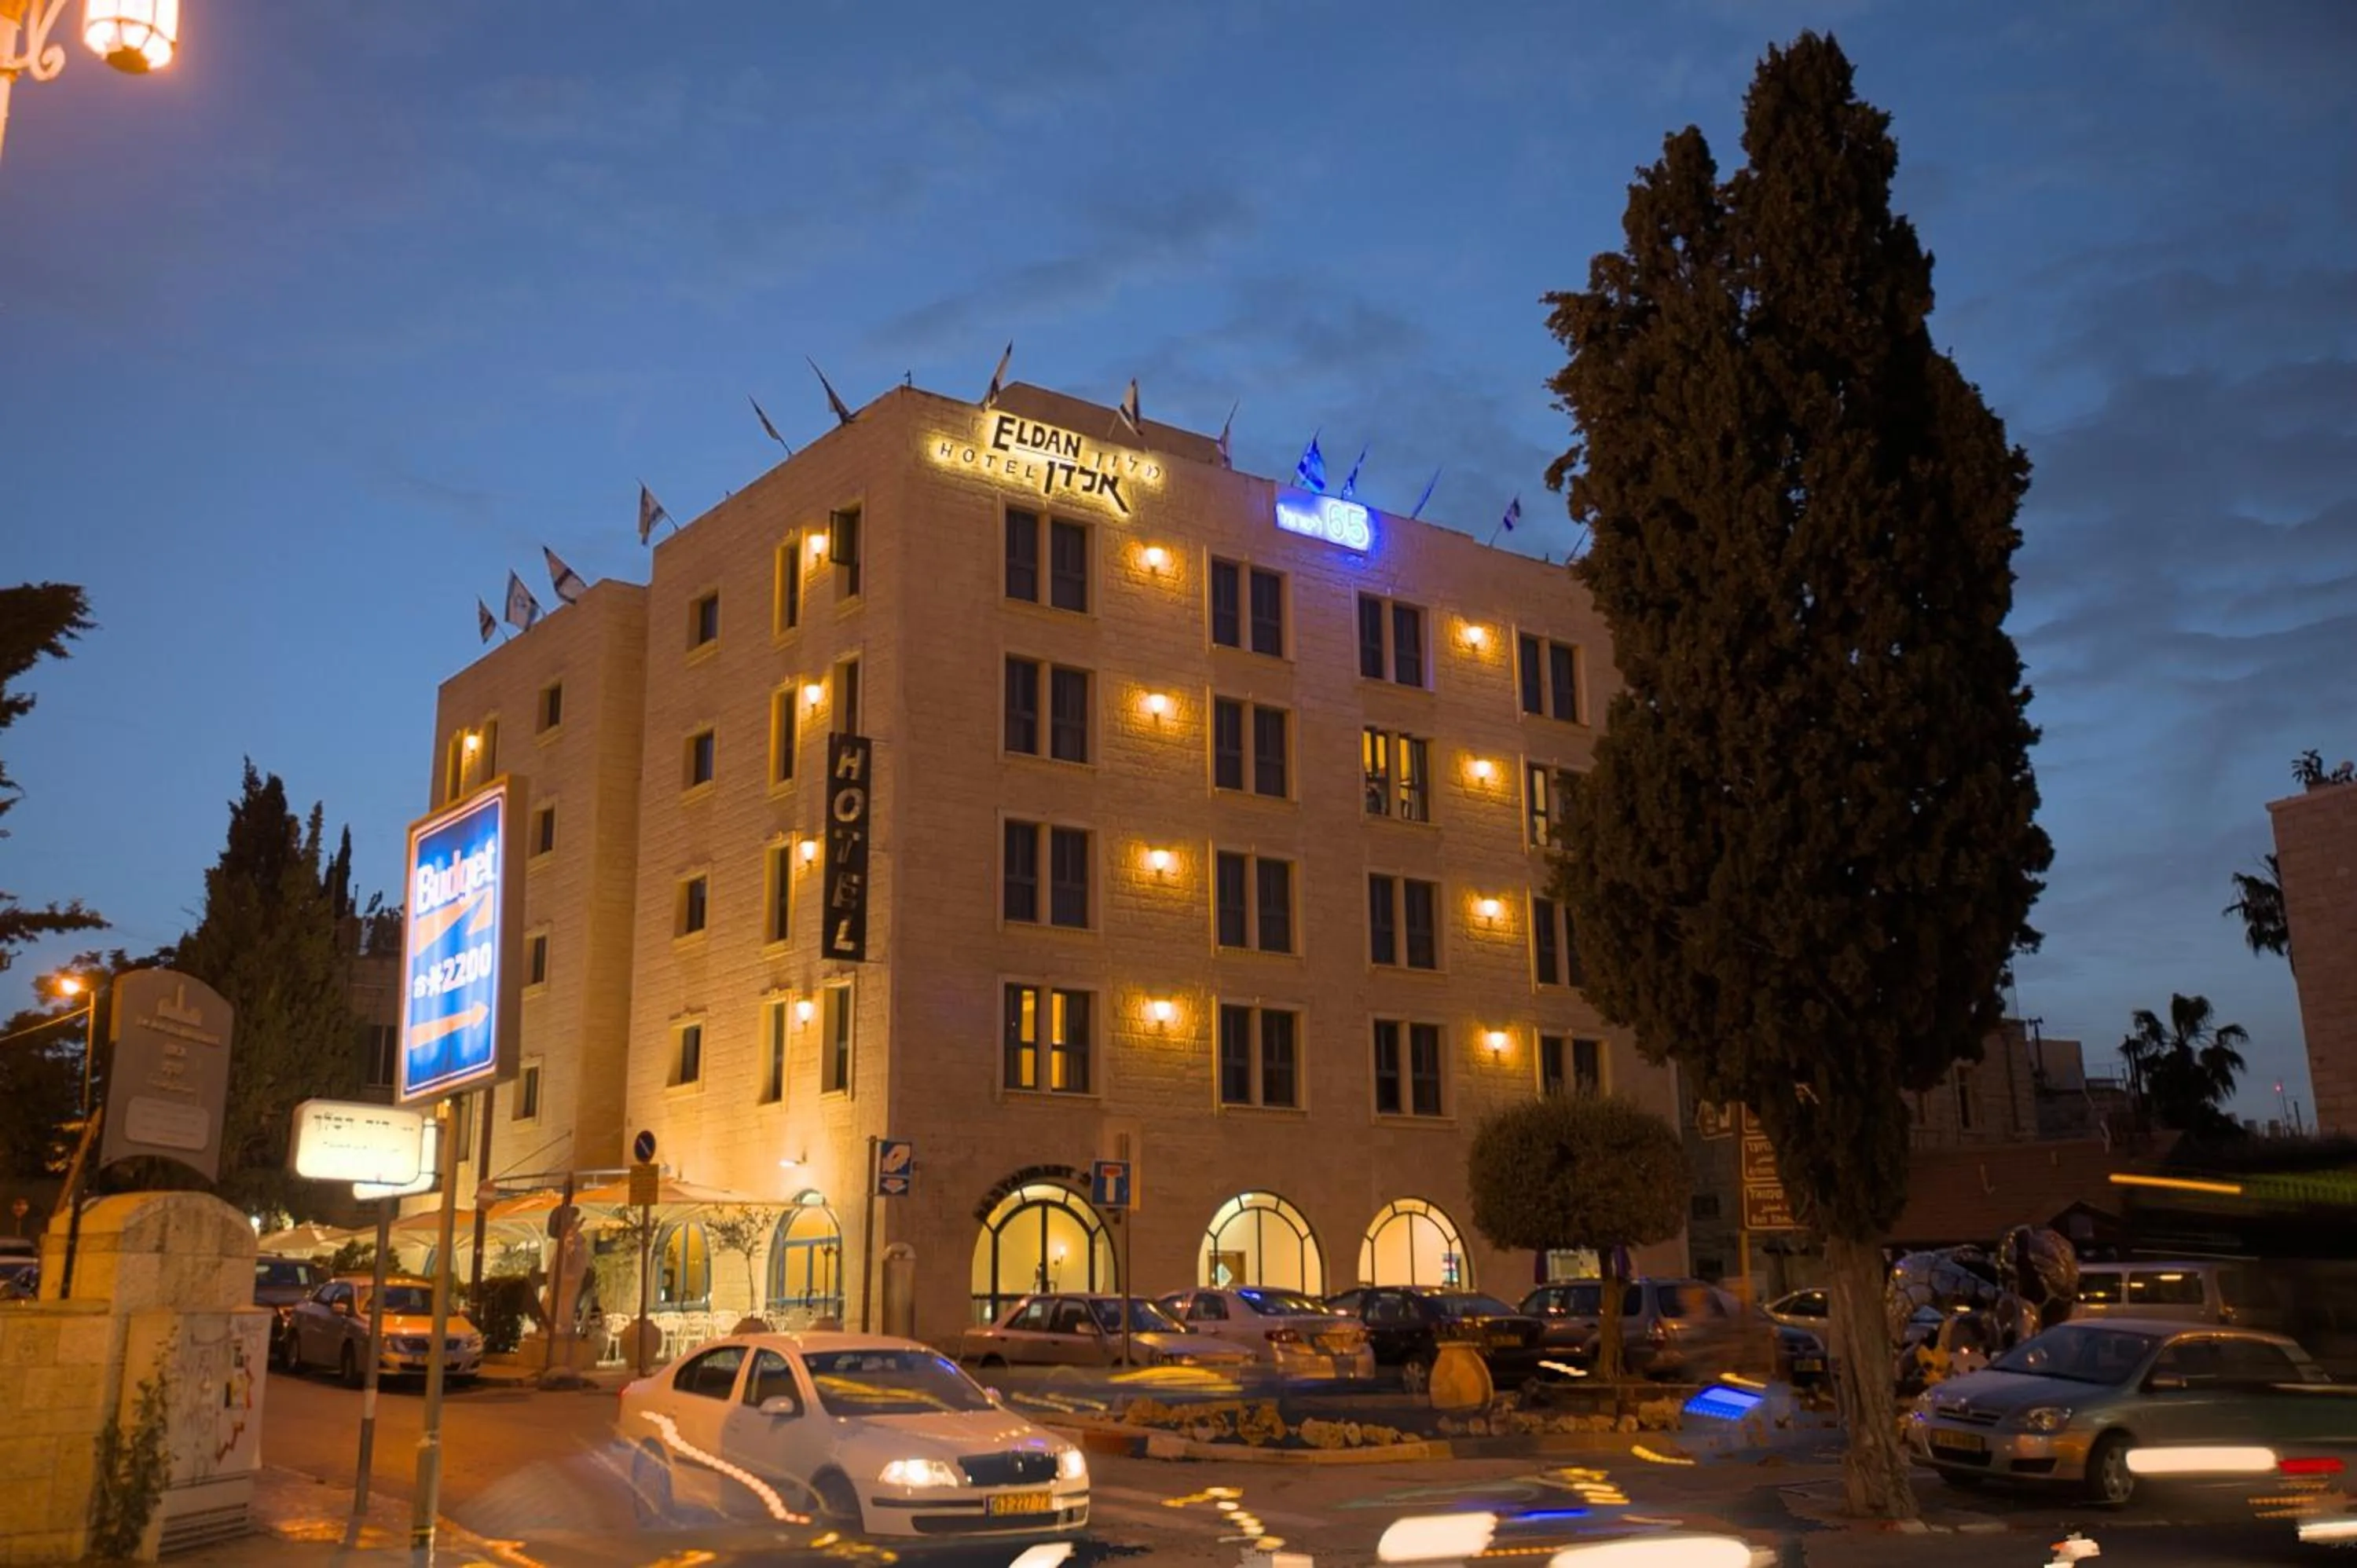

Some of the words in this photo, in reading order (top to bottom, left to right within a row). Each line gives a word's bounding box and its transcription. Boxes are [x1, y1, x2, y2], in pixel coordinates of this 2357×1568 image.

[992, 415, 1082, 458] ELDAN
[940, 441, 1037, 479] HOTEL
[1328, 502, 1367, 545] 65
[832, 746, 865, 952] HOTEL
[416, 841, 496, 915] Budget
